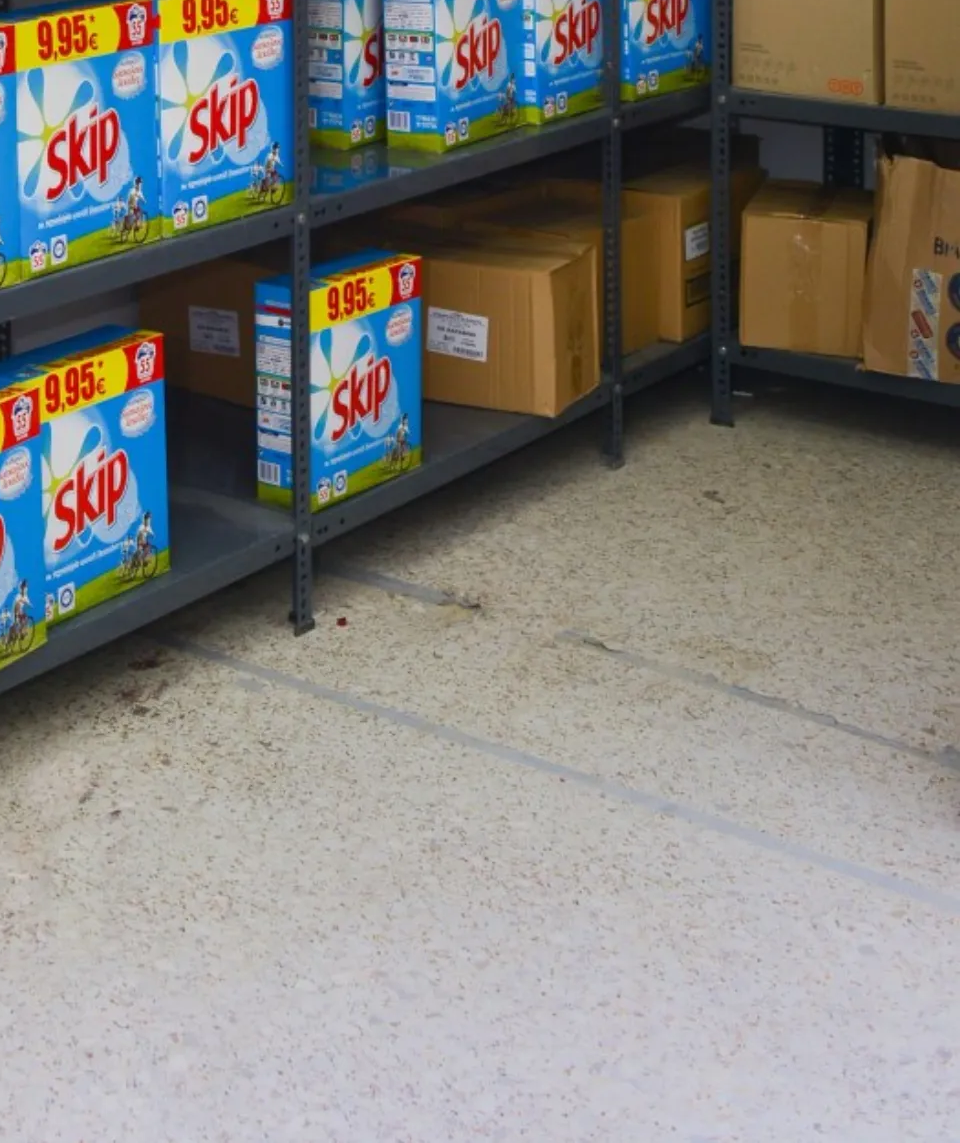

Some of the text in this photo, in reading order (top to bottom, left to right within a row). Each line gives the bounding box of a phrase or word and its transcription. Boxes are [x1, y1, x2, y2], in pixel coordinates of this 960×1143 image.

[453, 15, 502, 90] Skip
[44, 104, 121, 202] Skip
[187, 73, 260, 164] Skip
[330, 355, 392, 443] Skip
[52, 448, 130, 552] Skip
